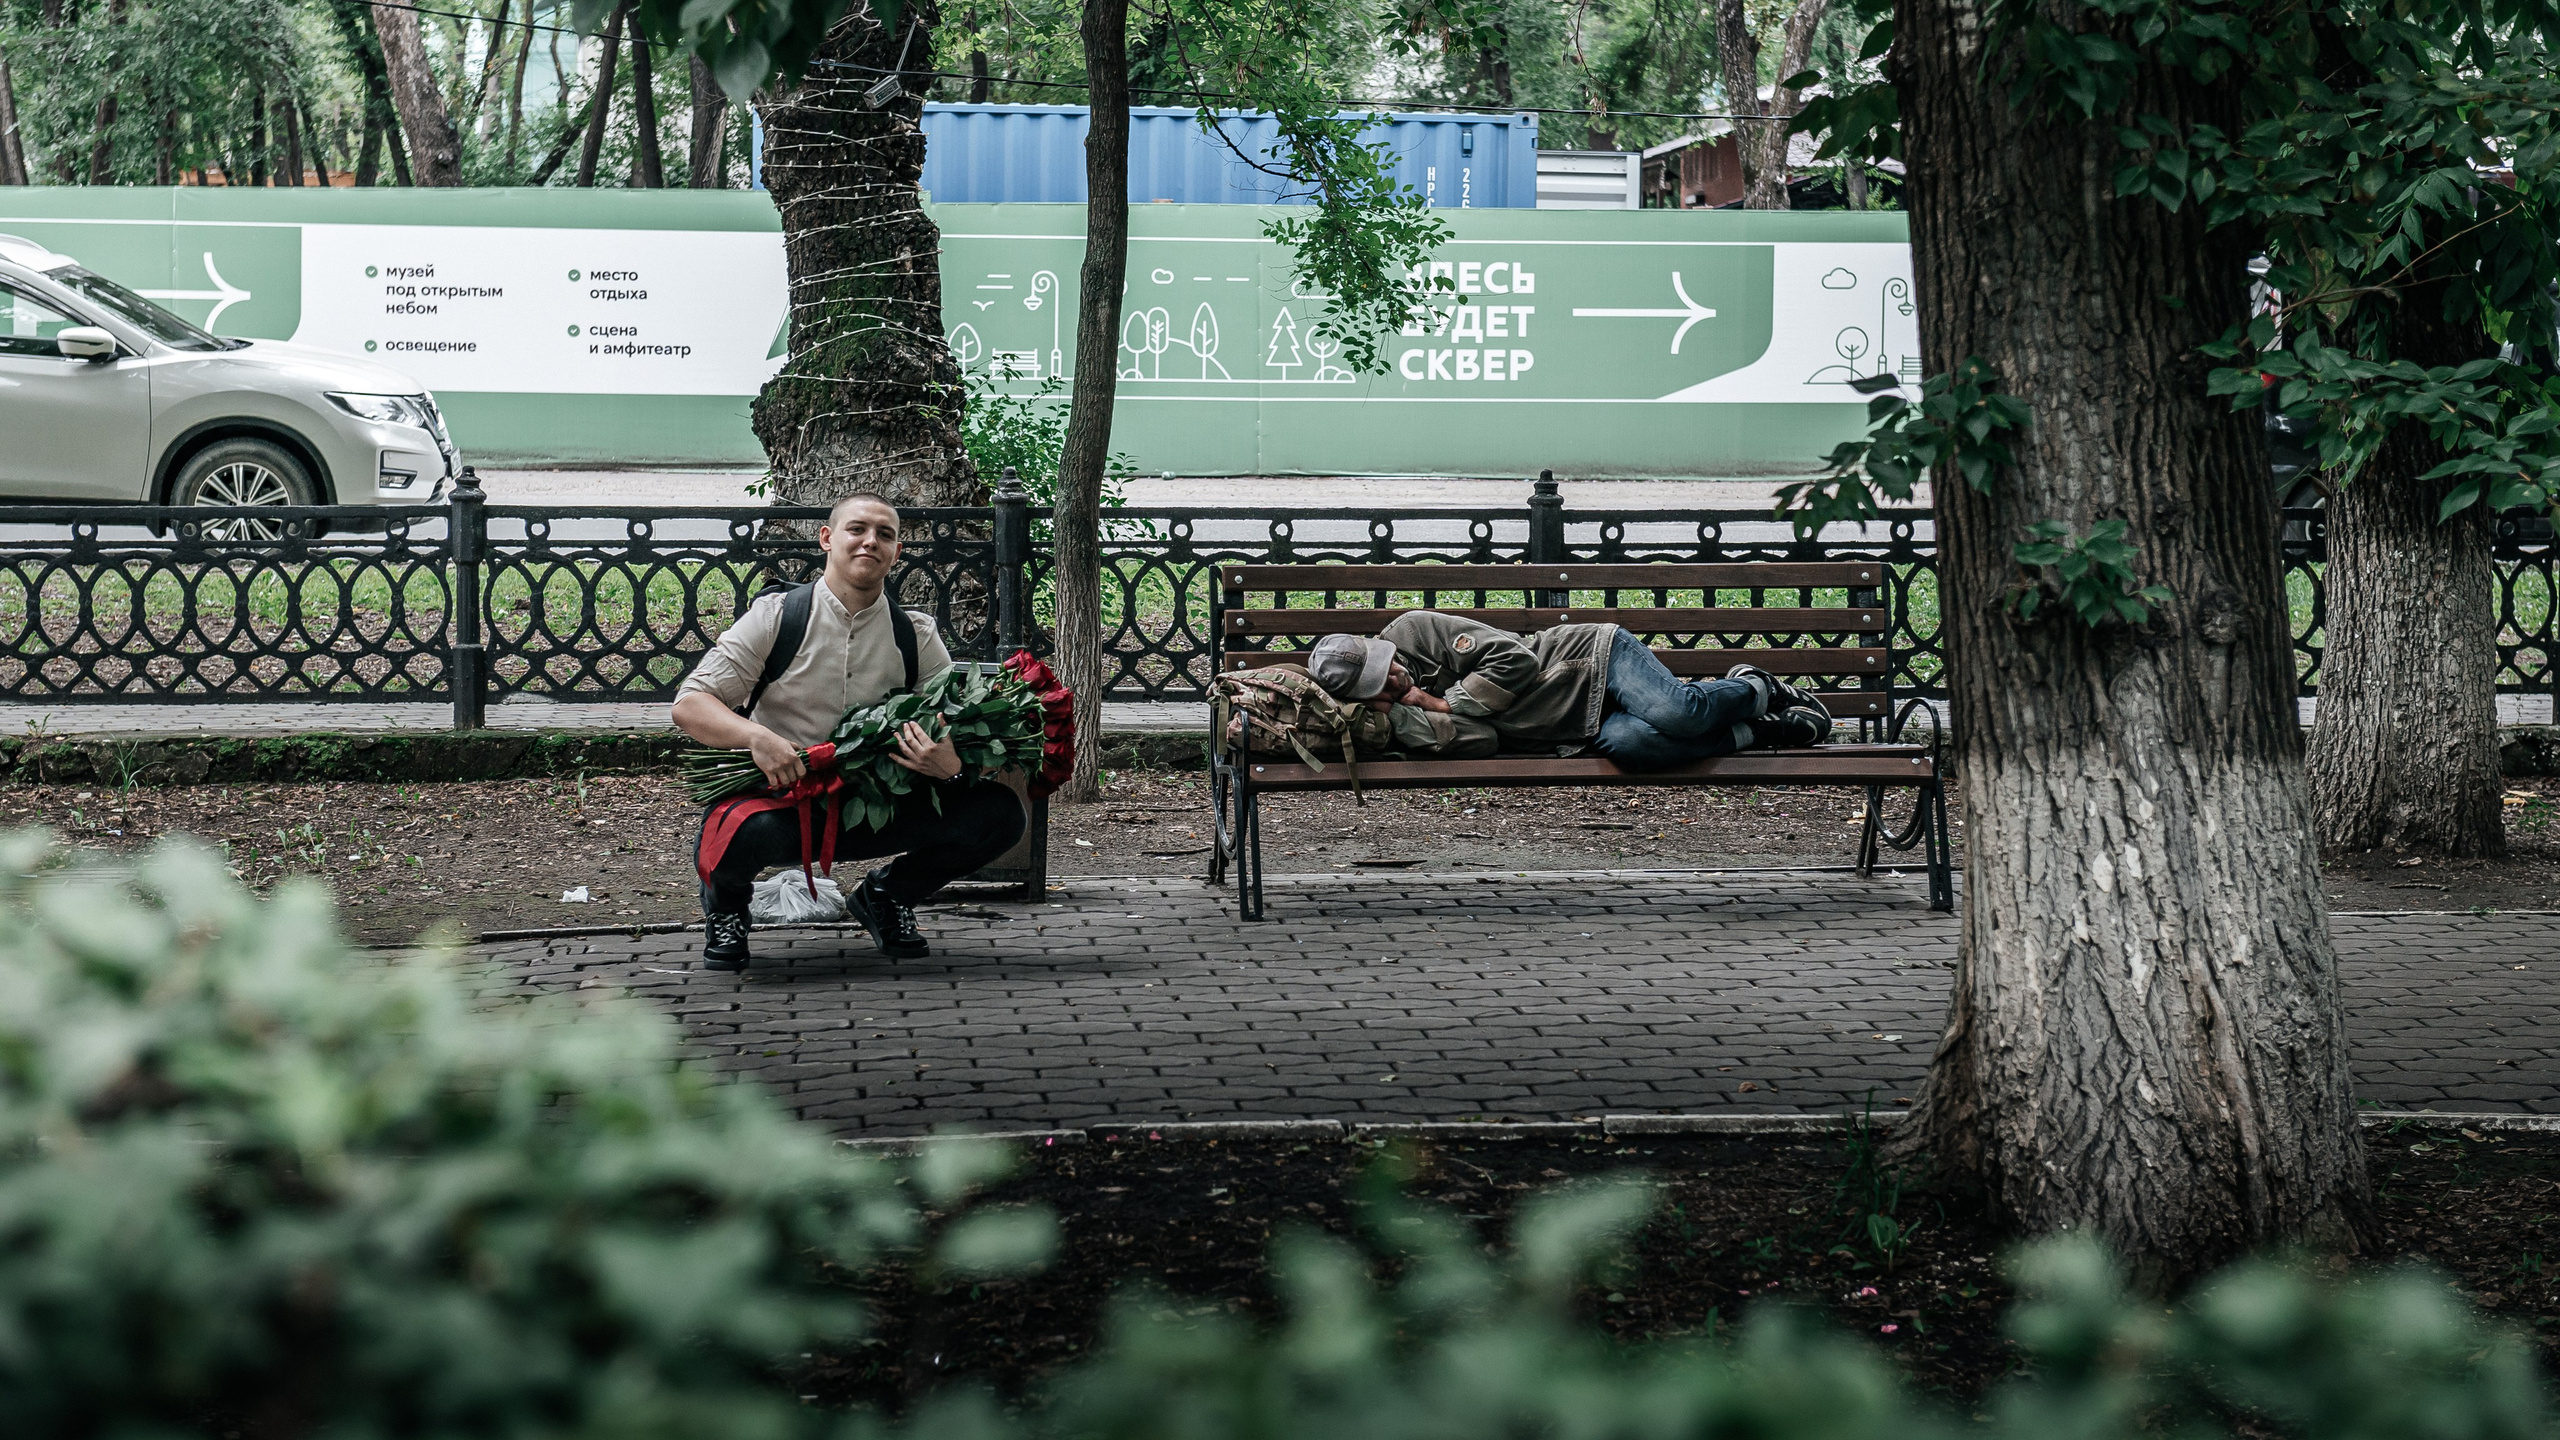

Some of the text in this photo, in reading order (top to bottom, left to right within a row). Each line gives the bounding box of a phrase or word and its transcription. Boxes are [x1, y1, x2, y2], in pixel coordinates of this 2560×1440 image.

[386, 264, 435, 281] музей
[589, 270, 639, 282] место
[386, 285, 503, 300] под открытым
[589, 288, 648, 301] отдыха
[386, 301, 438, 315] небом
[589, 325, 638, 338] сцена
[385, 340, 477, 355] освещение
[589, 342, 692, 359] и амфитеатр
[1399, 349, 1535, 381] СКВЕР
